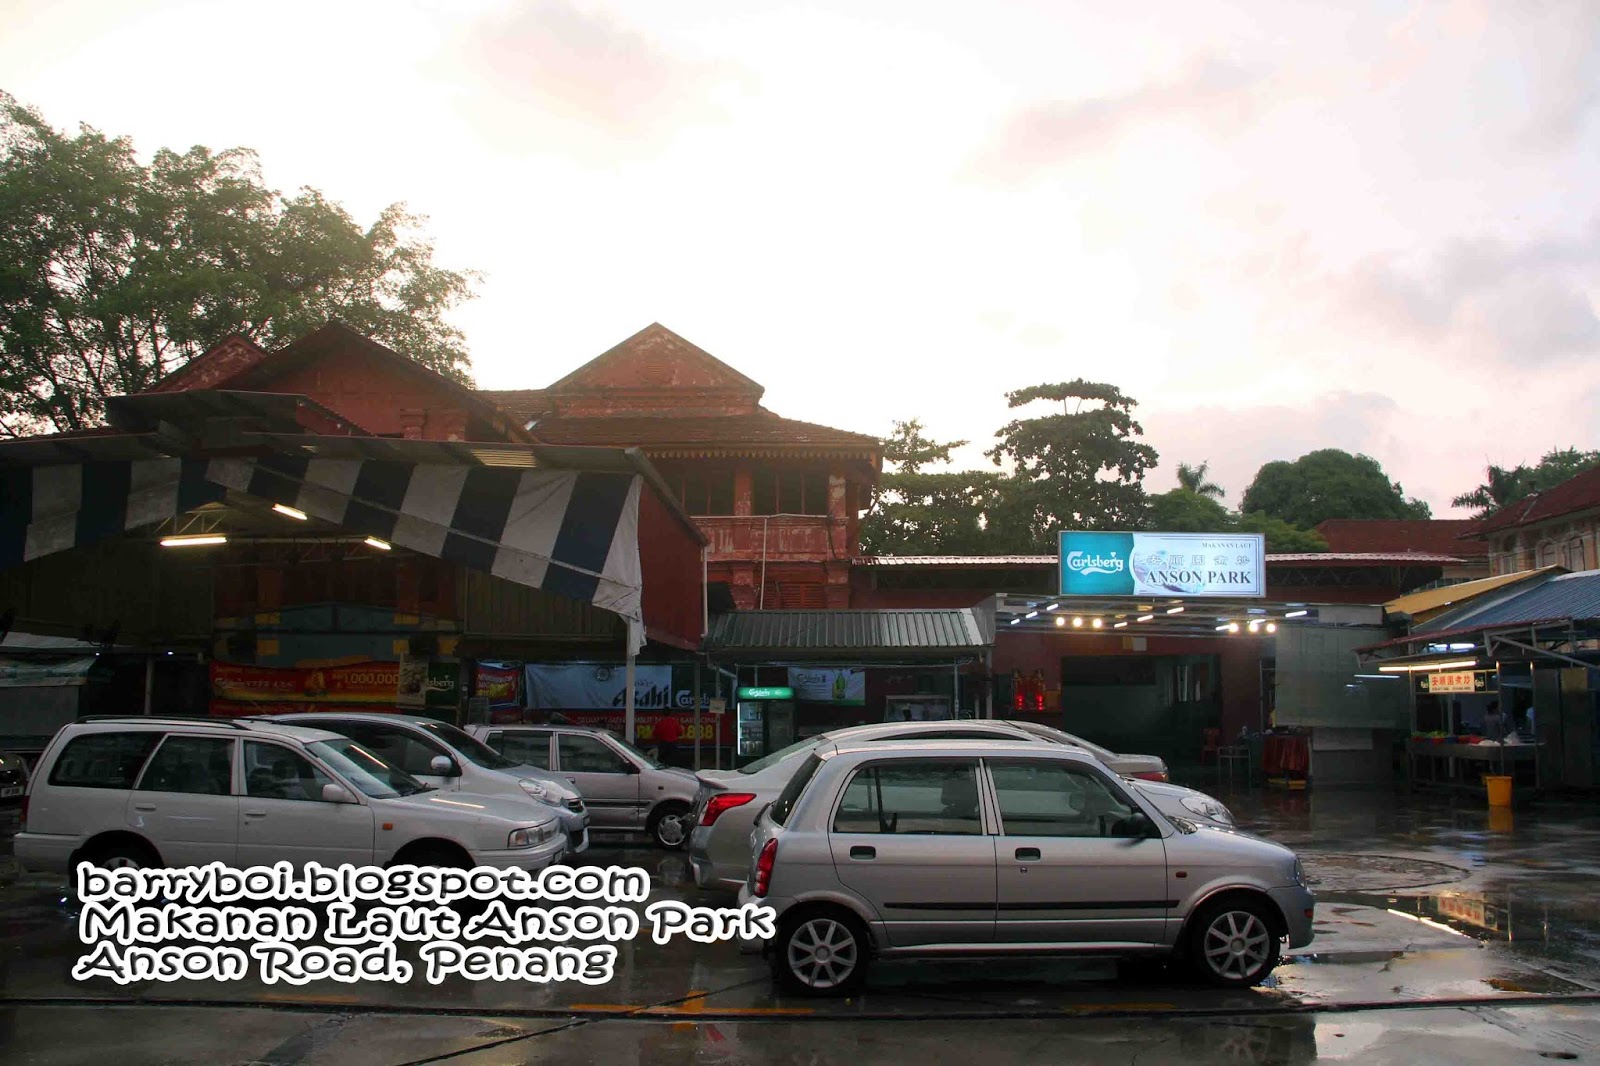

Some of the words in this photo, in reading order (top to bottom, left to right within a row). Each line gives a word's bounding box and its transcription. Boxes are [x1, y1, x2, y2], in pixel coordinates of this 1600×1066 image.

[1067, 551, 1124, 575] Carlsberg
[1146, 570, 1202, 584] ANSON
[1207, 570, 1251, 584] PARK
